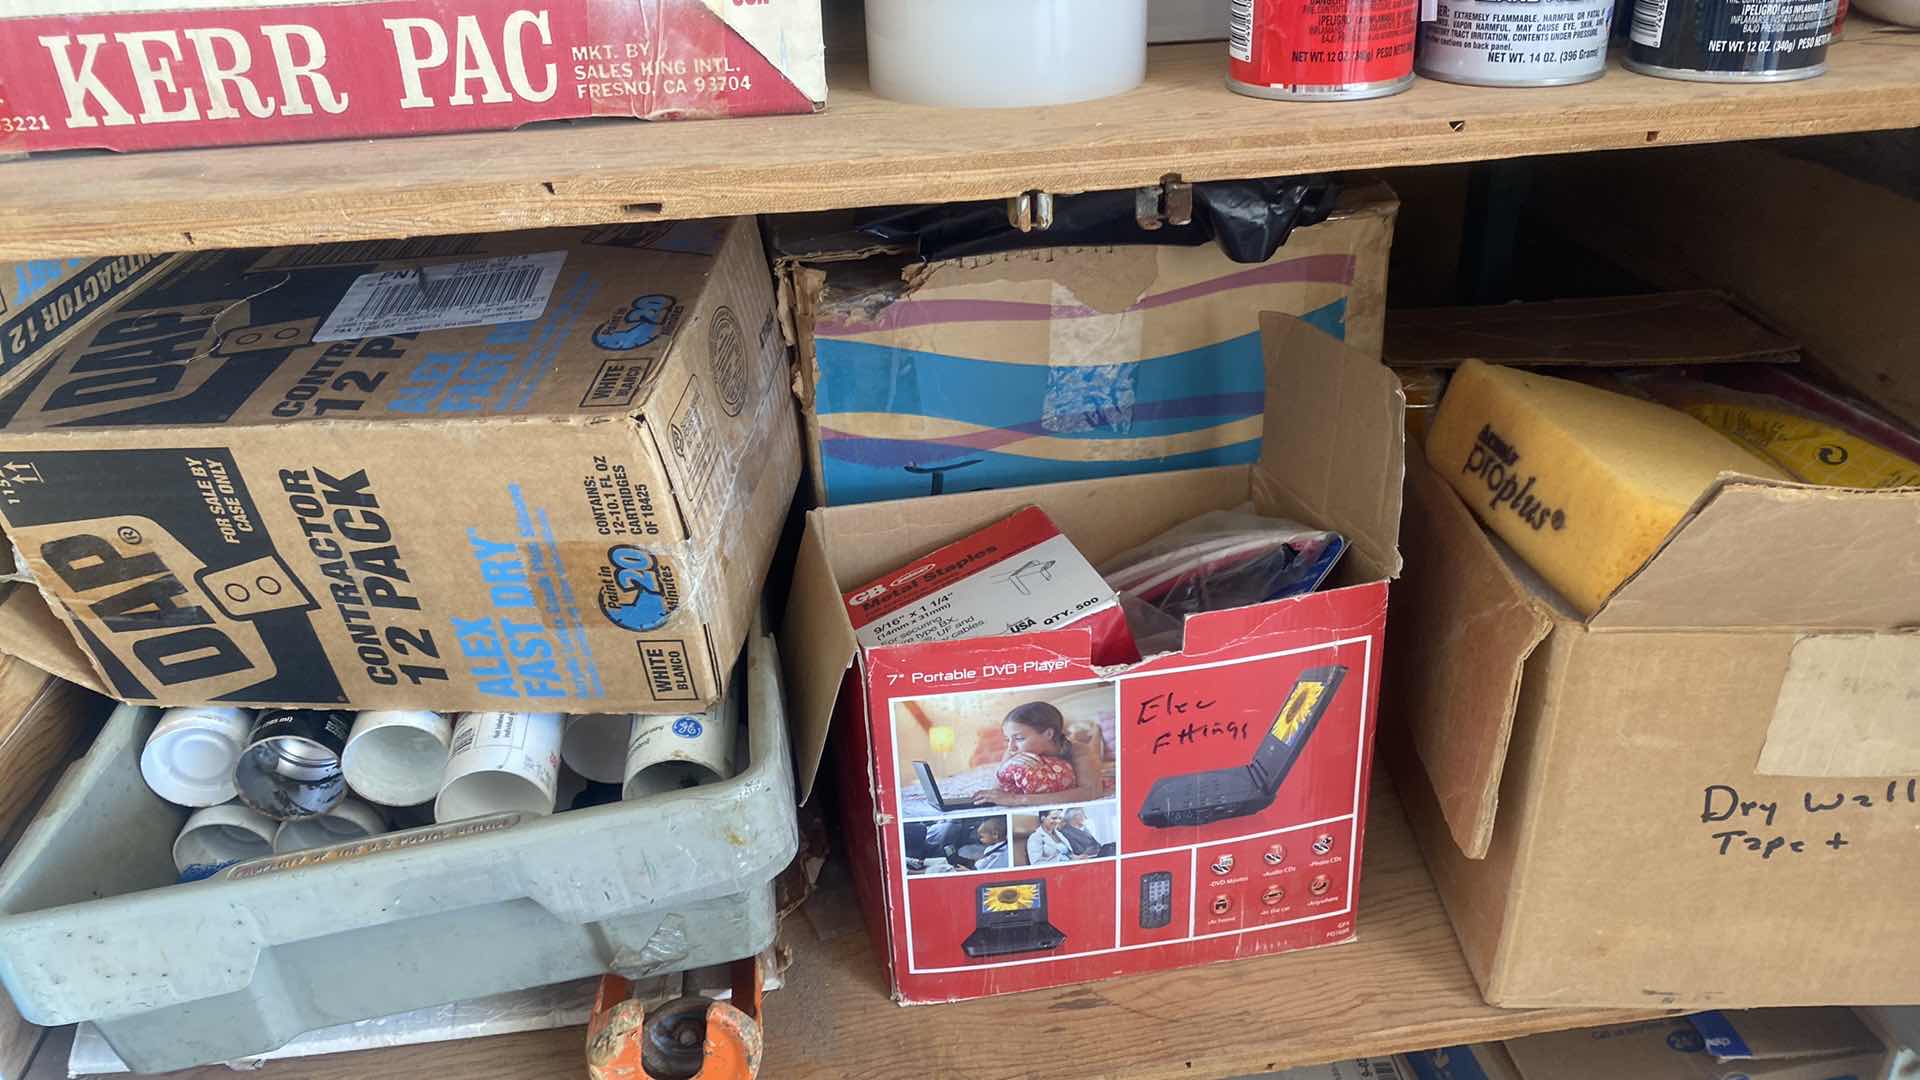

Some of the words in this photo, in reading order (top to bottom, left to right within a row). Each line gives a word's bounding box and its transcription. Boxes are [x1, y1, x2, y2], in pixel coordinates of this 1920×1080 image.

[1454, 11, 1490, 20] EXTREMELY
[1543, 13, 1575, 22] HARMFUL
[1516, 24, 1532, 32] MAY
[1536, 23, 1560, 32] CAUSE
[571, 46, 619, 61] MKT.
[624, 43, 650, 58] BY
[1451, 29, 1469, 39] TRACT
[1512, 33, 1549, 42] CONTENTS
[1550, 32, 1572, 40] UNDER
[1473, 41, 1489, 50] back
[1708, 40, 1727, 52] NET
[1728, 41, 1744, 52] WT.
[1747, 41, 1757, 52] 12
[1773, 40, 1796, 53] (340g)
[1797, 37, 1814, 50] PESO
[38, 24, 349, 129] KERR
[383, 9, 558, 109] PAC
[575, 63, 633, 80] SALES
[641, 60, 687, 76] KING
[693, 56, 740, 73] INTL.
[1292, 51, 1308, 62] NET
[1327, 52, 1336, 62] 12
[1487, 52, 1506, 63] NET
[1508, 53, 1525, 63] WT.
[1529, 53, 1541, 63] 14
[1543, 52, 1557, 63] OZ.
[1560, 50, 1577, 64] (396
[576, 81, 656, 99] FRESNO,
[663, 79, 688, 94] CA
[694, 75, 752, 93] 93704
[41, 254, 163, 332] NTRACTOR
[8, 319, 39, 354] 12
[314, 371, 390, 417] 12
[591, 366, 625, 400] WHITE
[185, 456, 209, 477] BY
[205, 458, 235, 495] ONLY
[593, 455, 608, 471] OZ
[196, 479, 226, 515] SALE
[599, 475, 613, 488] FL
[223, 496, 254, 532] CASE
[583, 475, 611, 535] CONTAINS:
[604, 493, 627, 535] 12-10.1
[612, 464, 643, 535] CARTRIDGES
[634, 483, 655, 518] 18425
[215, 518, 241, 544] FOR
[312, 466, 422, 611] PACK
[644, 521, 659, 535] OF
[279, 468, 398, 686] CONTRACTOR
[467, 527, 538, 609] DRY
[597, 565, 612, 578] in
[608, 544, 664, 593] 20
[863, 576, 919, 611] Metal
[924, 545, 998, 581] Staples
[603, 577, 622, 609] Paint
[872, 615, 905, 635] 9/16"
[919, 605, 928, 613] 1
[929, 592, 954, 607] 1/4"
[876, 622, 910, 642] (14mm
[917, 602, 952, 620] 31mm)
[900, 616, 943, 639] securing
[951, 620, 985, 639] cables
[954, 615, 975, 630] and
[1010, 618, 1037, 633] USA
[1043, 609, 1074, 626] QTY.
[1076, 597, 1099, 611] 500
[915, 625, 937, 639] type
[385, 628, 450, 687] 12
[450, 615, 521, 699] ALEX
[501, 615, 567, 698] FAST
[646, 648, 673, 693] WHITE
[668, 650, 689, 691] BLANCO
[911, 667, 977, 684] Portable
[982, 664, 1018, 678] DVD
[1023, 658, 1072, 675] Player
[1701, 785, 1777, 826] Dry
[1712, 831, 1805, 859] Tape
